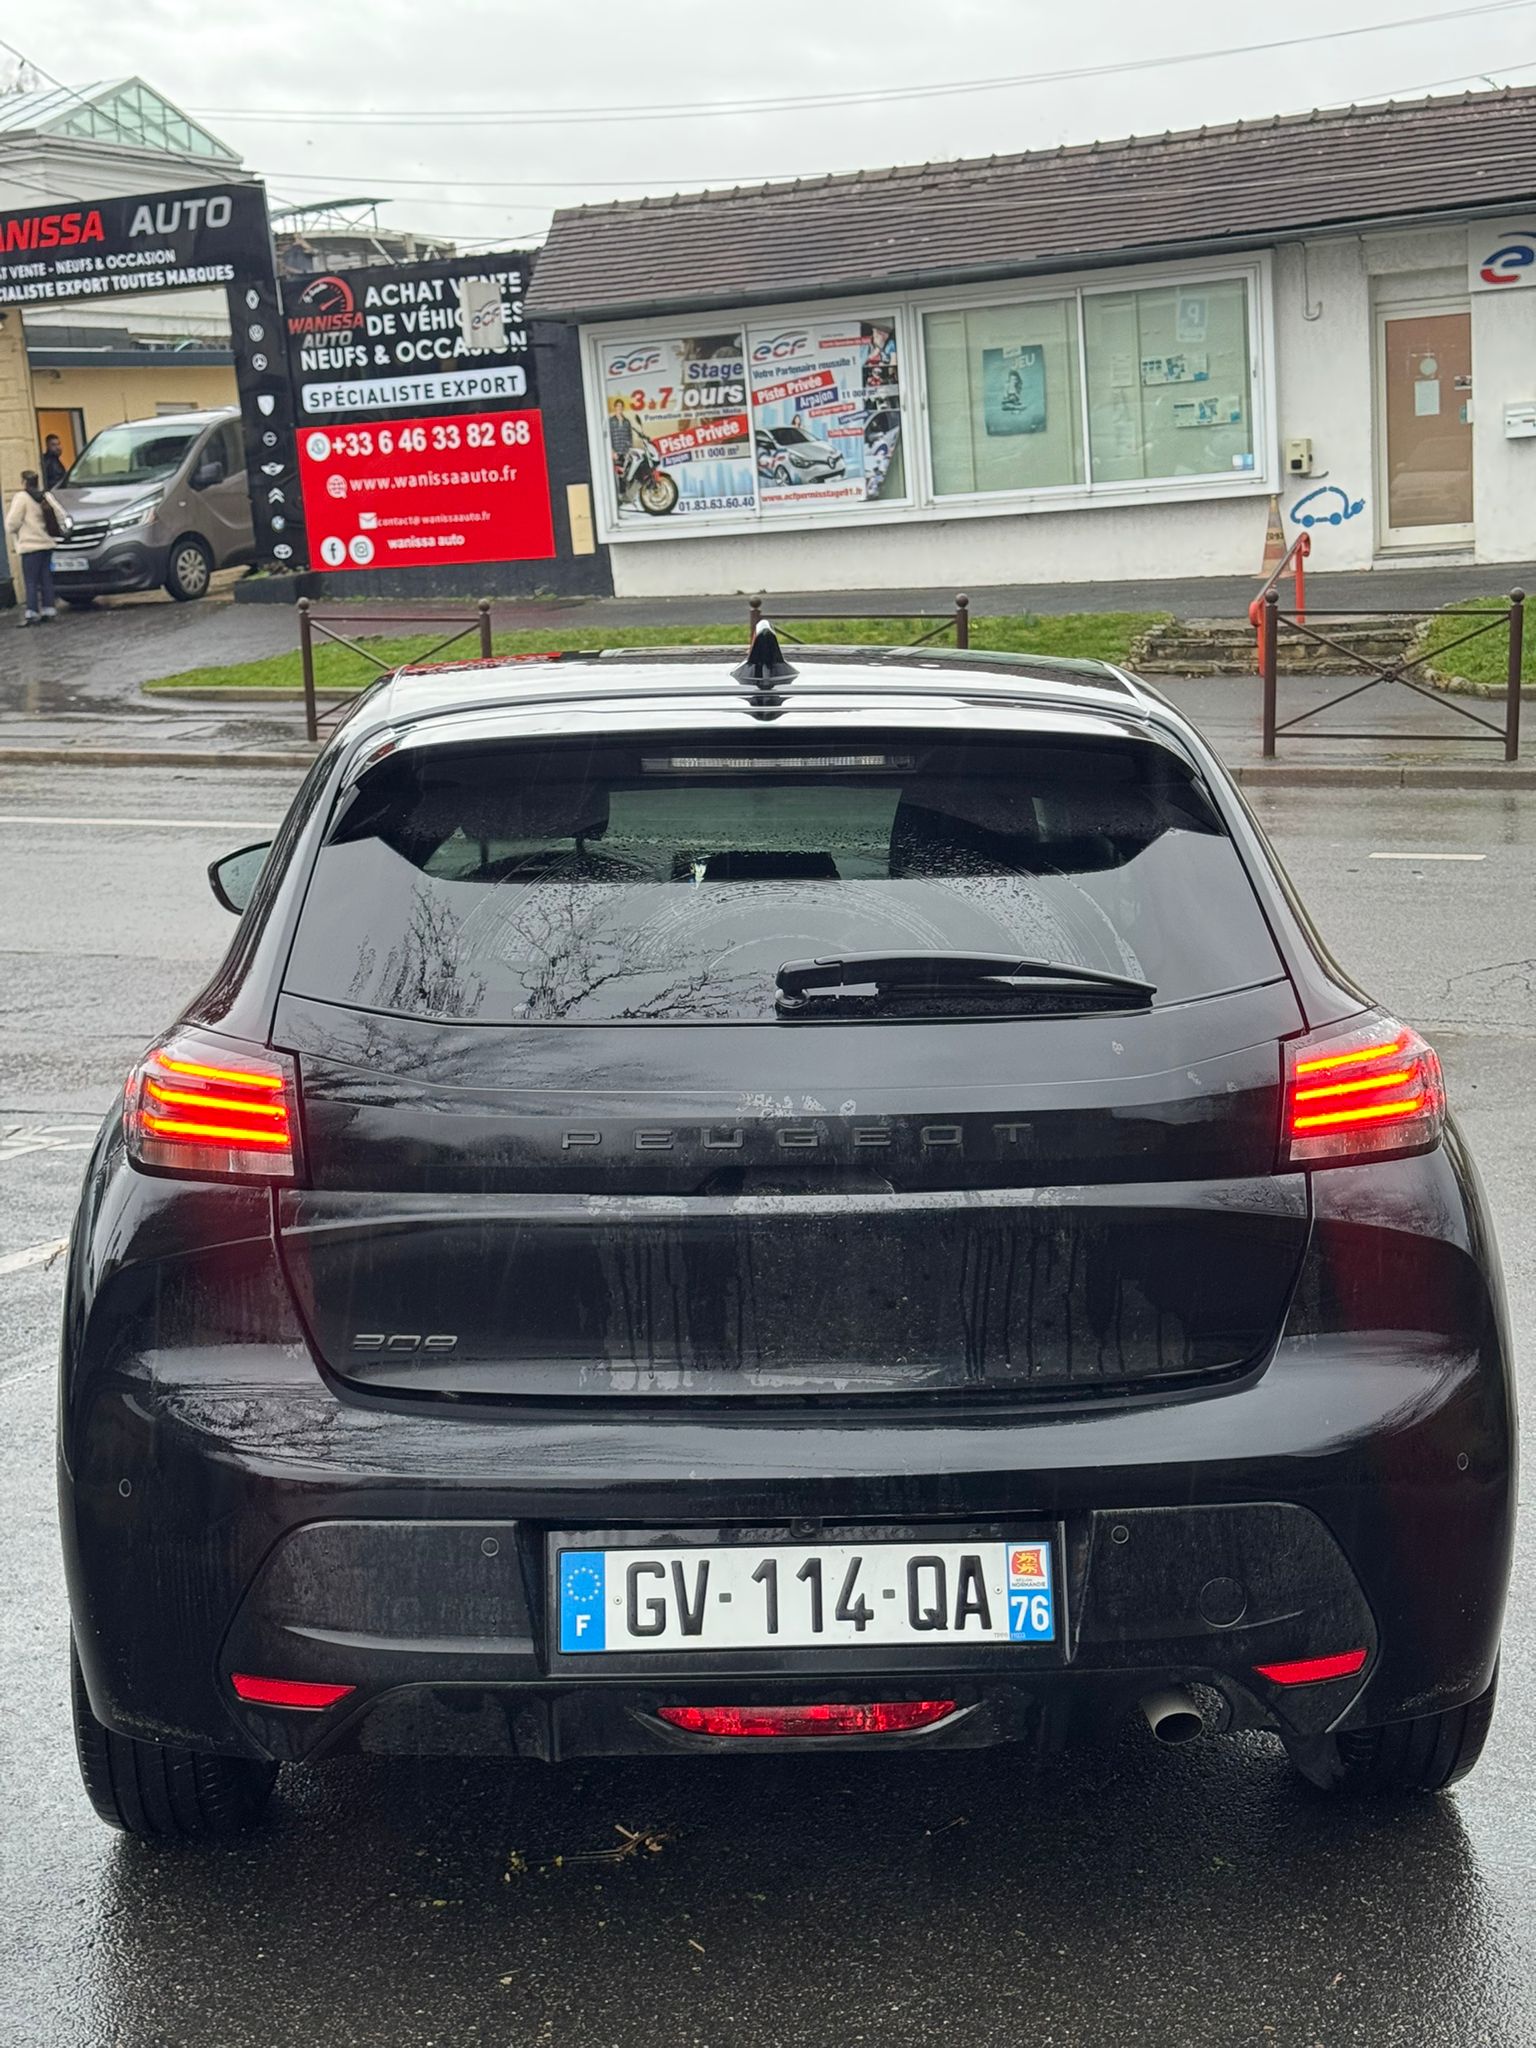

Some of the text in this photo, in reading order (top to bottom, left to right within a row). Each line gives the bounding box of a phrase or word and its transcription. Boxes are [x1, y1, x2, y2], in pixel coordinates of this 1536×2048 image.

[0, 195, 233, 252] NISSA AUTO
[8, 262, 47, 280] VENTE
[55, 257, 94, 276] NEUFS
[95, 256, 105, 271] &
[106, 249, 176, 270] OCCASION
[55, 276, 110, 297] EXPORT
[111, 271, 165, 292] TOUTES
[165, 264, 235, 287] MARQUES
[364, 279, 444, 308] ACHAT
[287, 312, 365, 335] WANISSA
[366, 313, 396, 337] DE
[302, 330, 353, 349] AUTO
[300, 344, 369, 371] NEUFS
[374, 344, 391, 365] &
[688, 361, 744, 380] Stage
[309, 375, 519, 408] SPÉCIALISTE EXPORT
[630, 389, 646, 412] 3
[659, 387, 674, 410] 7
[674, 383, 744, 413] jours
[757, 375, 823, 404] Piste Privée
[800, 390, 834, 410] Arpajon
[331, 420, 531, 457] +33 6 46 33 82 68
[658, 420, 740, 454] Piste Privée
[349, 465, 518, 492] www.wanissaauto.fr
[387, 532, 466, 550] wanissa auto
[561, 1122, 1032, 1151] PEUGEOT
[353, 1333, 458, 1352] 208
[626, 1554, 992, 1637] GV-114-QA
[576, 1615, 591, 1637] F
[1010, 1594, 1050, 1632] 76
